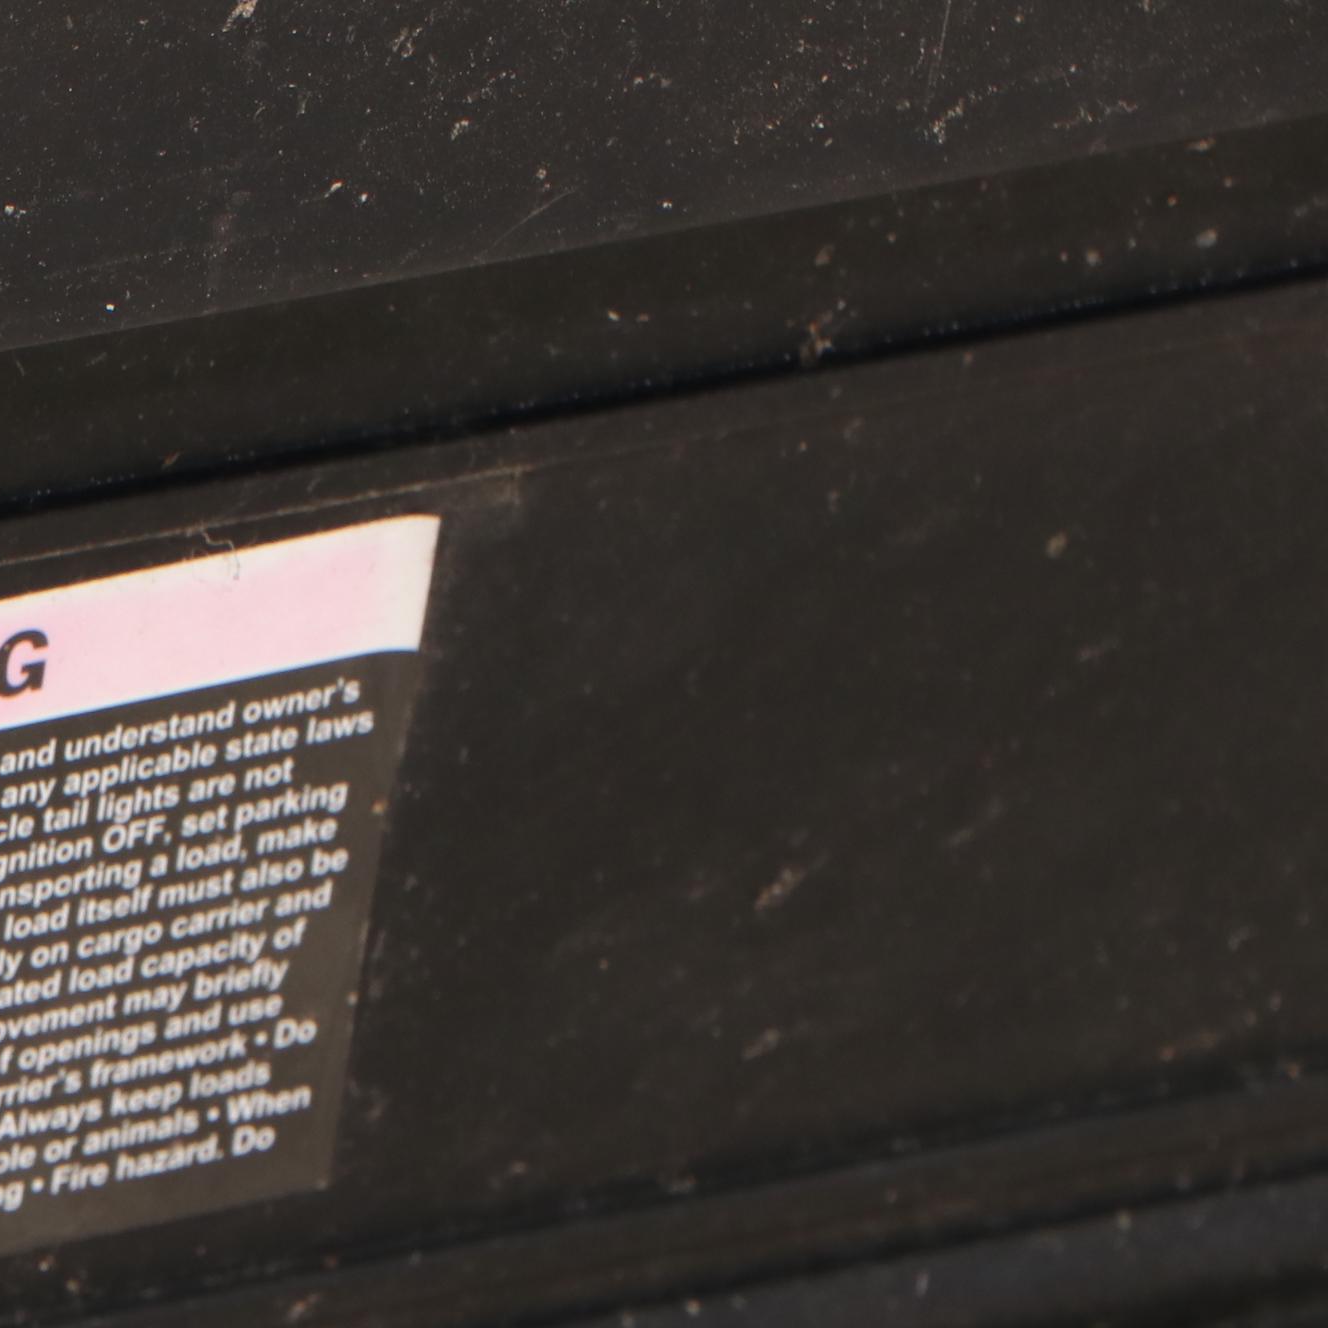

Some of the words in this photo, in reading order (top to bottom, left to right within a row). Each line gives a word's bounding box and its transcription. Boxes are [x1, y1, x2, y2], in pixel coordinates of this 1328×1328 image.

[63, 700, 236, 762] understand
[242, 677, 361, 724] owner's
[0, 777, 57, 809] any
[62, 741, 218, 799] applicable
[225, 726, 299, 761] state
[43, 796, 90, 833] tail
[96, 784, 180, 826] lights
[187, 773, 237, 803] are
[101, 815, 172, 853] OFF,
[181, 804, 229, 837] set
[3, 902, 70, 941] load
[30, 941, 70, 969] on
